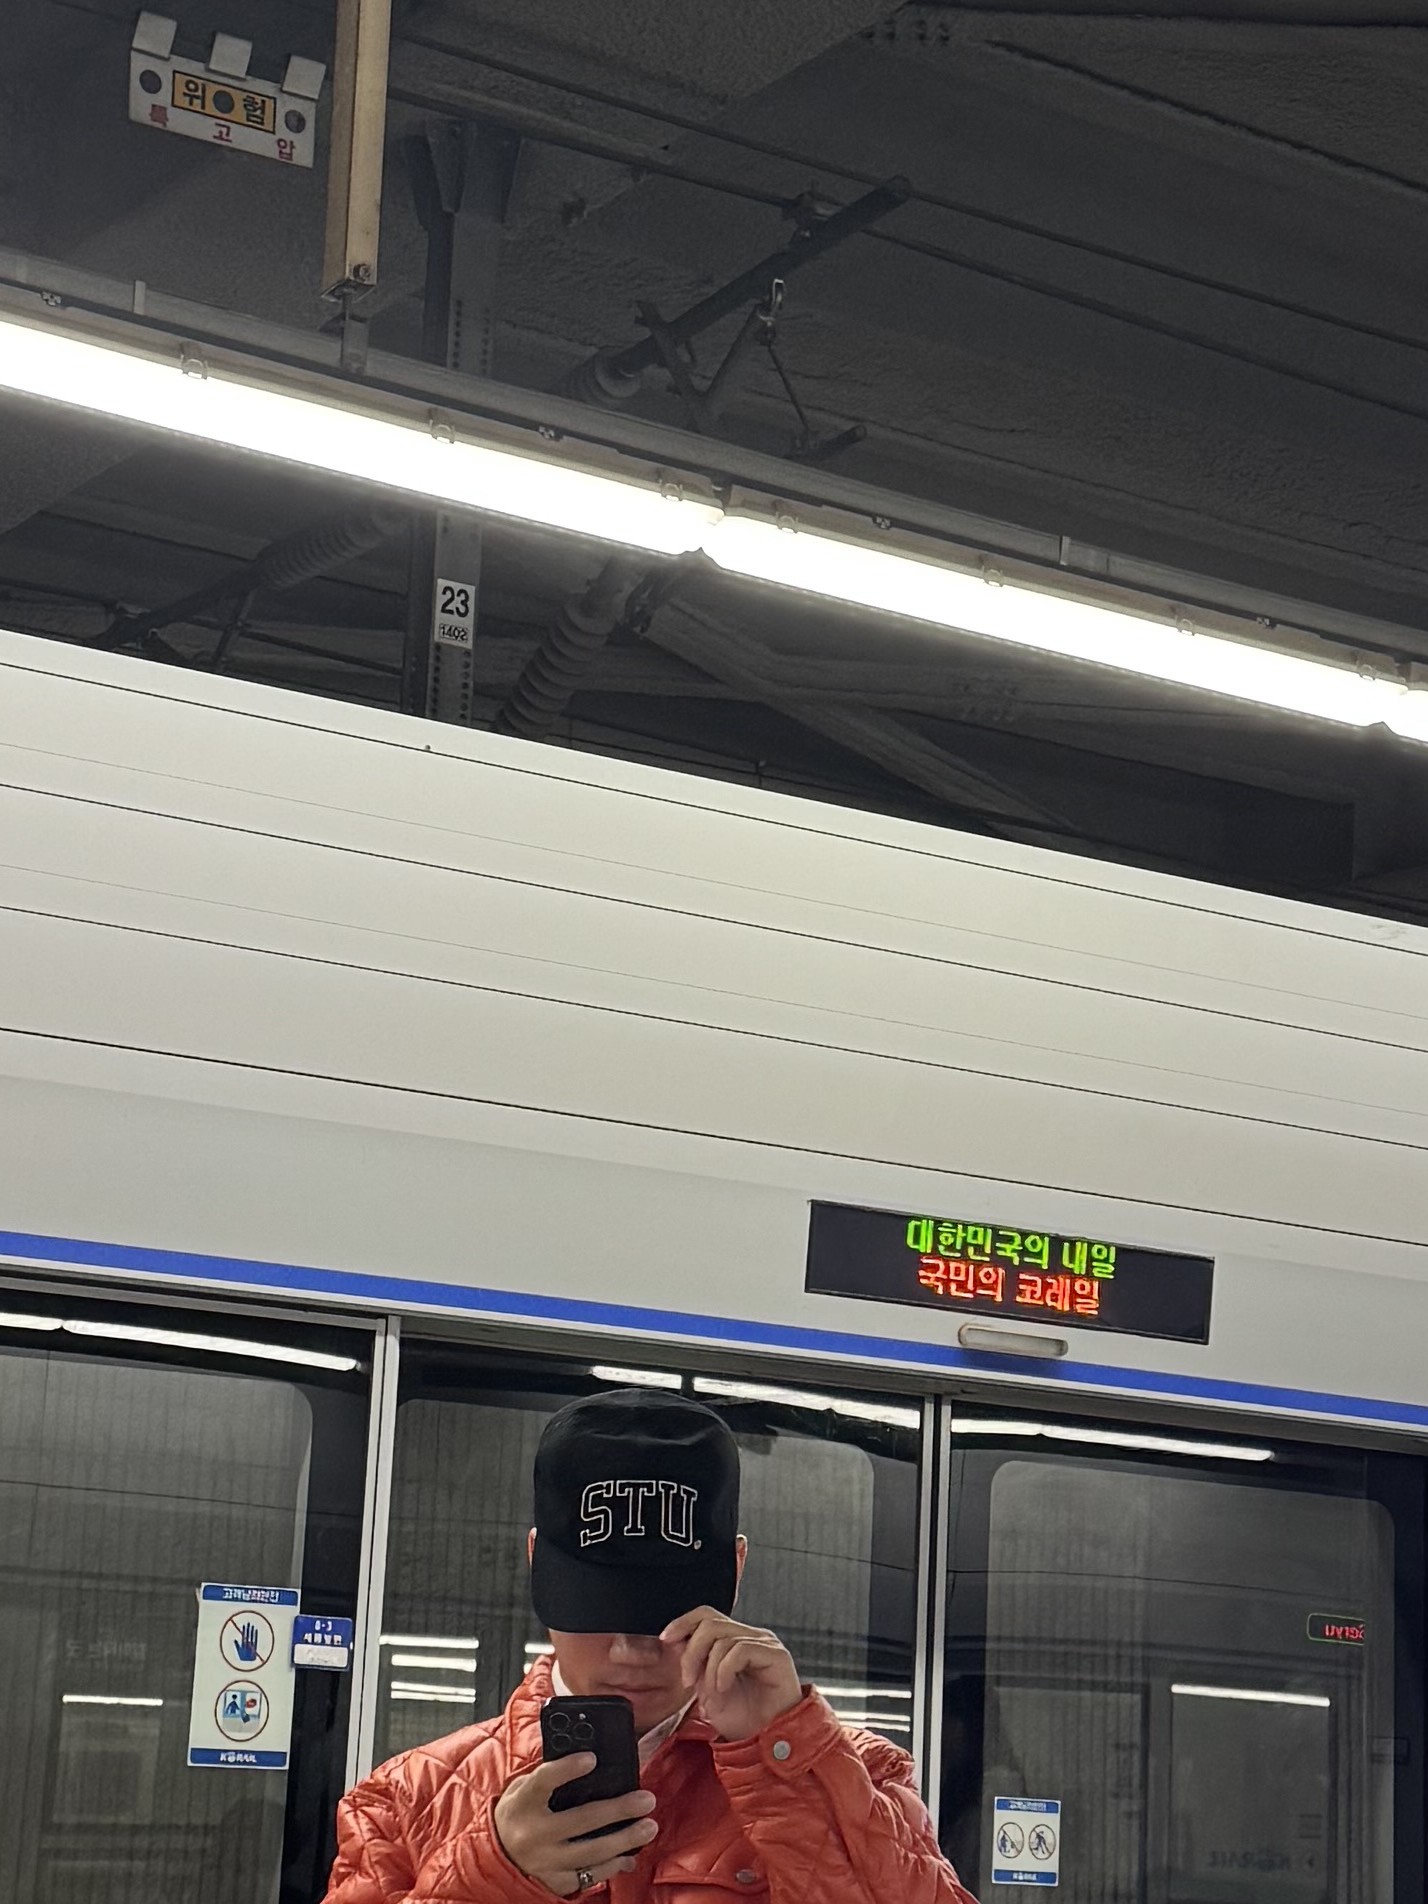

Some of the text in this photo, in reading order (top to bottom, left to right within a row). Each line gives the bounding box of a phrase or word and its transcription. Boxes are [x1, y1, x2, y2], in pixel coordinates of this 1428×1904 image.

[182, 78, 267, 127] 위험
[440, 586, 470, 618] 23
[906, 1218, 1118, 1280] 대한민국의 내일
[918, 1256, 1100, 1316] 국민의 코레일
